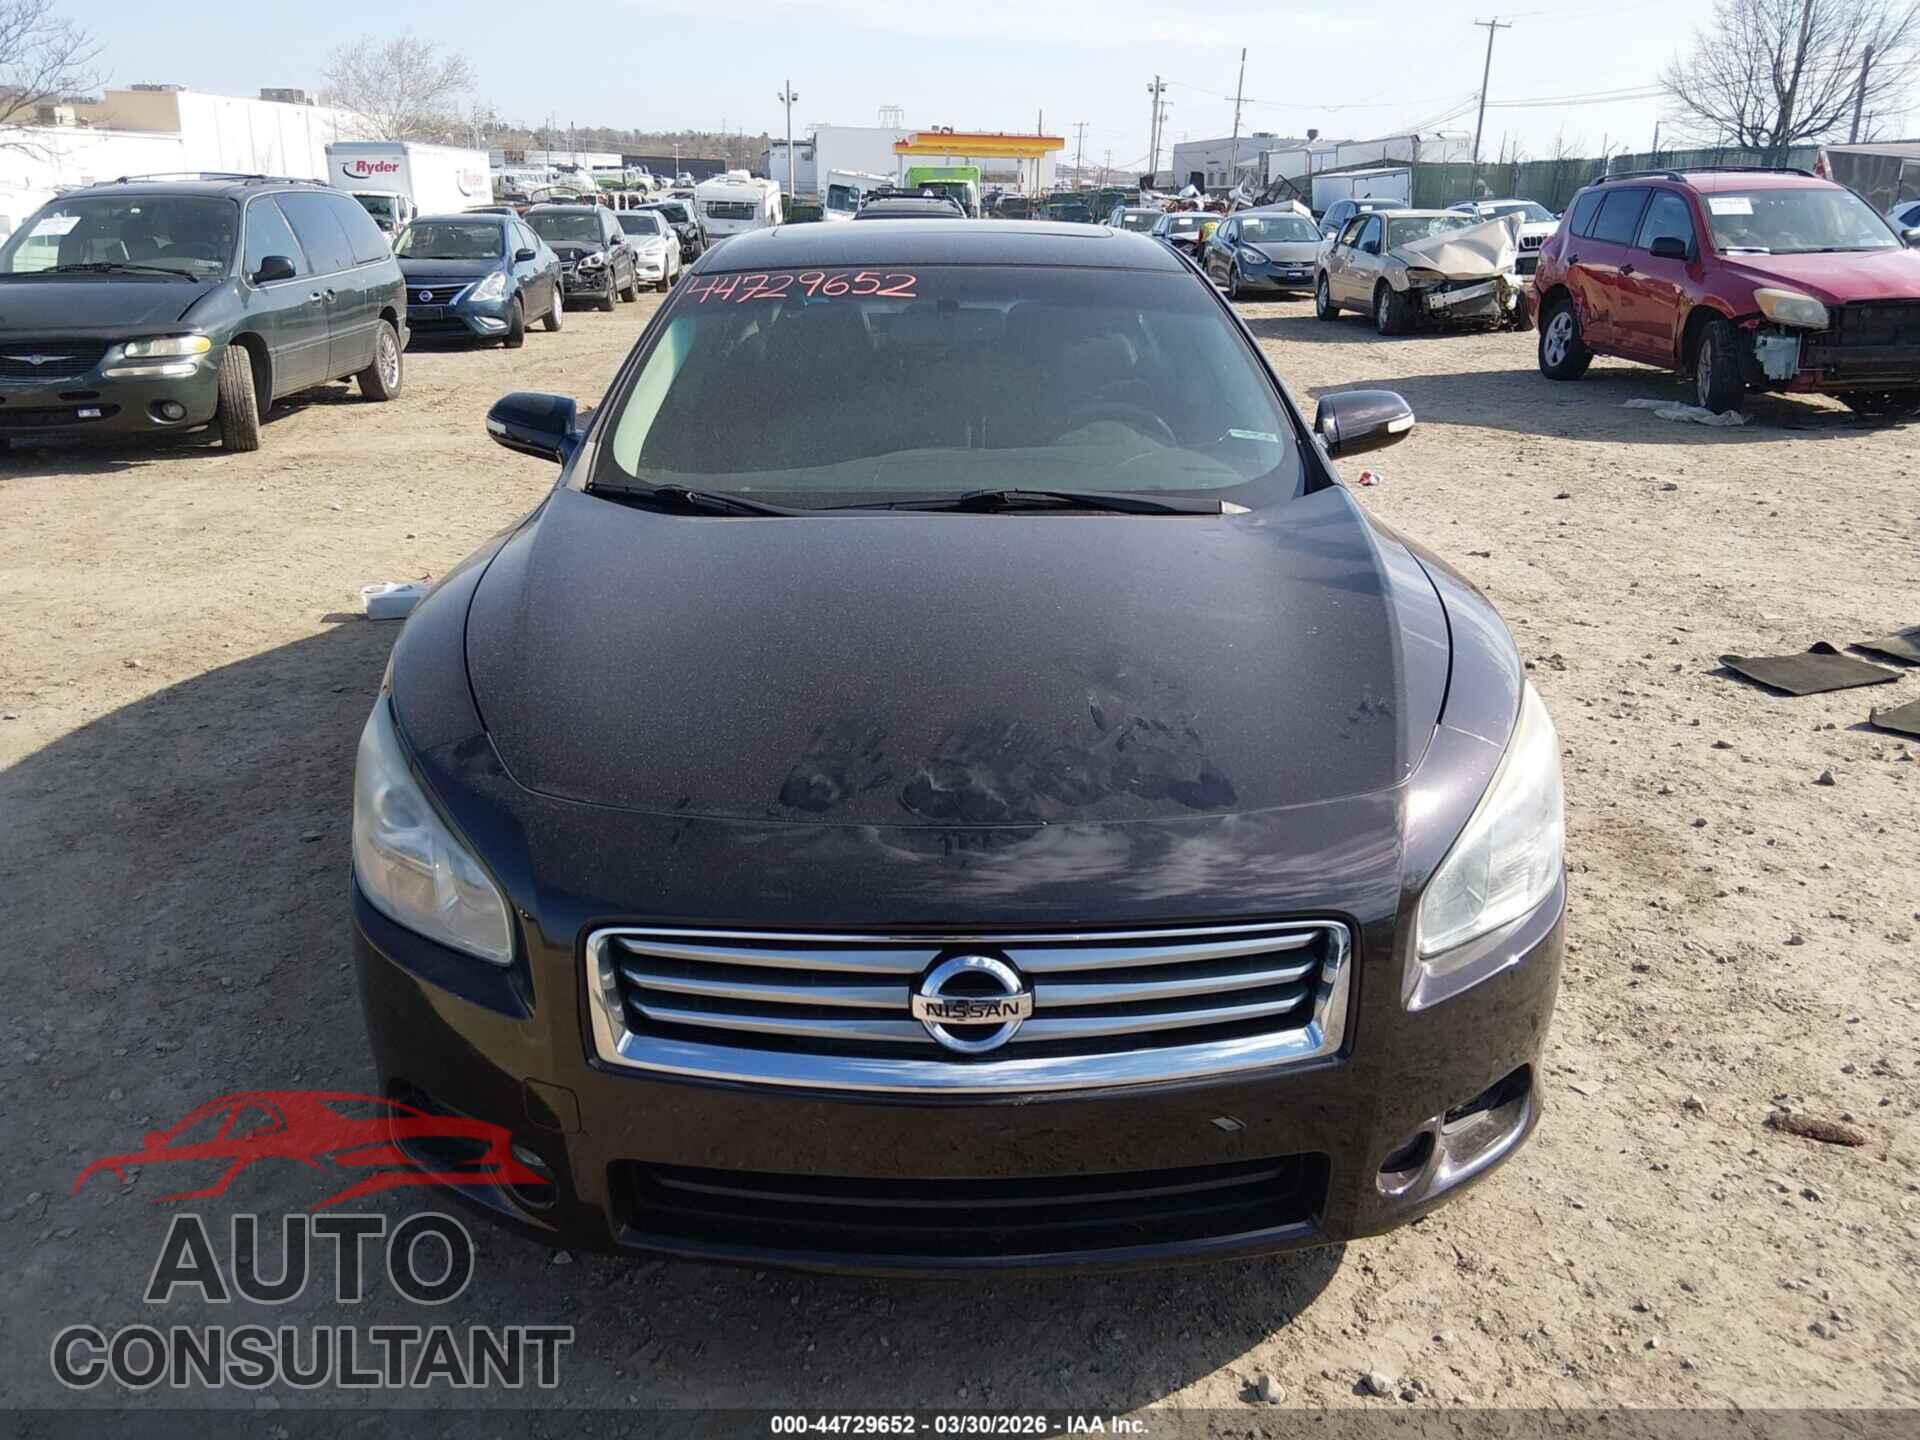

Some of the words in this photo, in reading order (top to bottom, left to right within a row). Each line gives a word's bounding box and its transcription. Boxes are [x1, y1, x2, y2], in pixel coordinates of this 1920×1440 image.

[356, 160, 400, 175] Ryder
[687, 271, 917, 303] 44729652
[925, 1001, 1020, 1018] NISSAN
